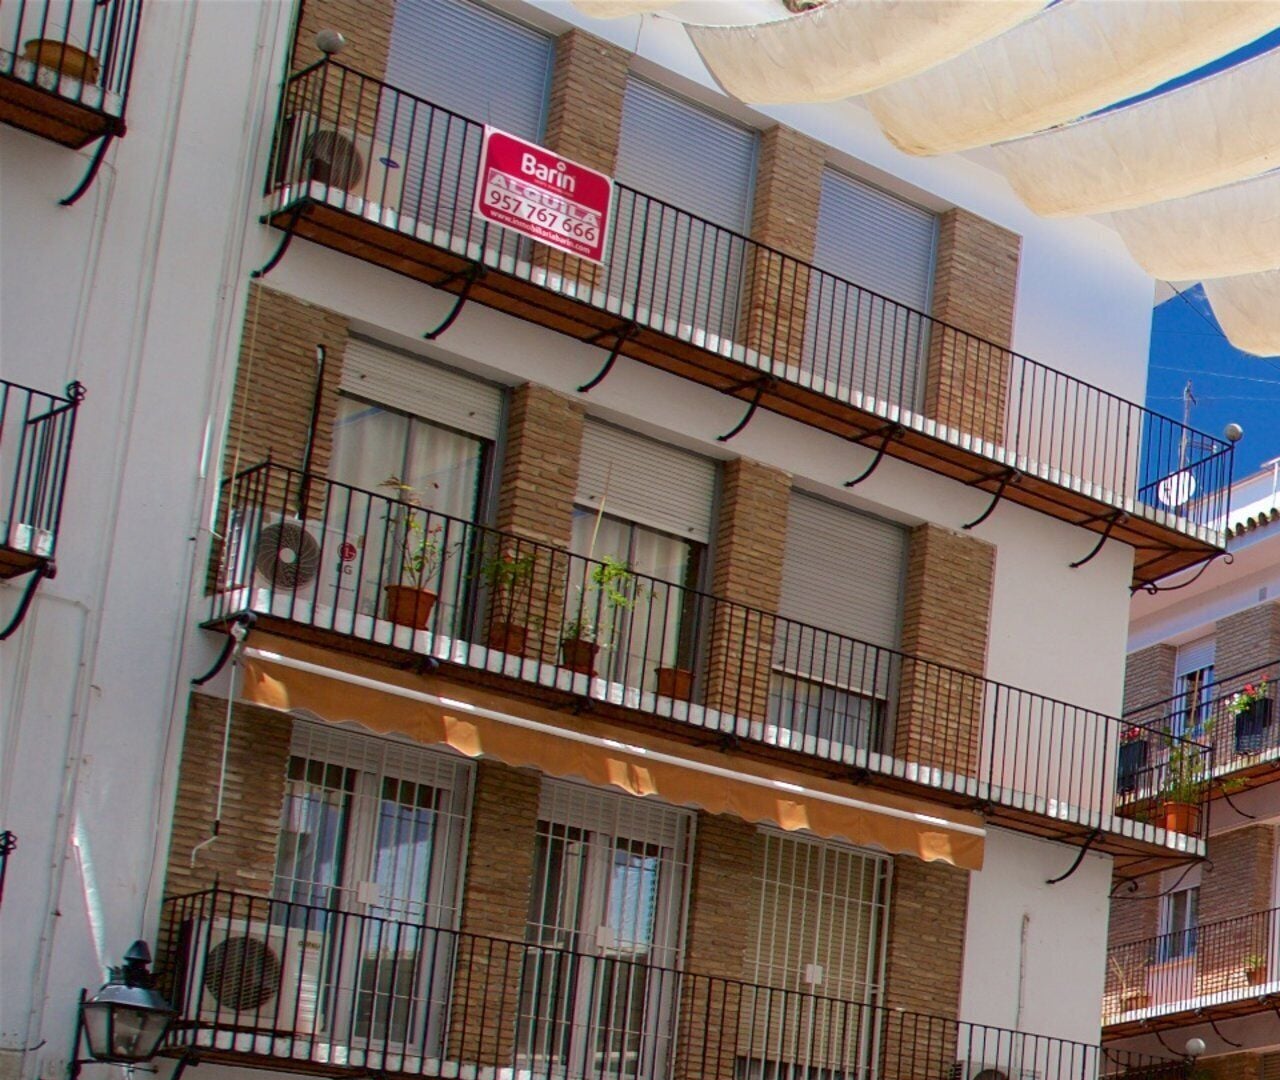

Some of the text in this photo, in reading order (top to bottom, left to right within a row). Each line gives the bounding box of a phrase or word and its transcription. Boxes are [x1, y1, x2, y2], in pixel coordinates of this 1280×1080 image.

[520, 152, 577, 193] Barin
[490, 174, 600, 228] ALQUILA
[490, 191, 595, 241] 957 767 666
